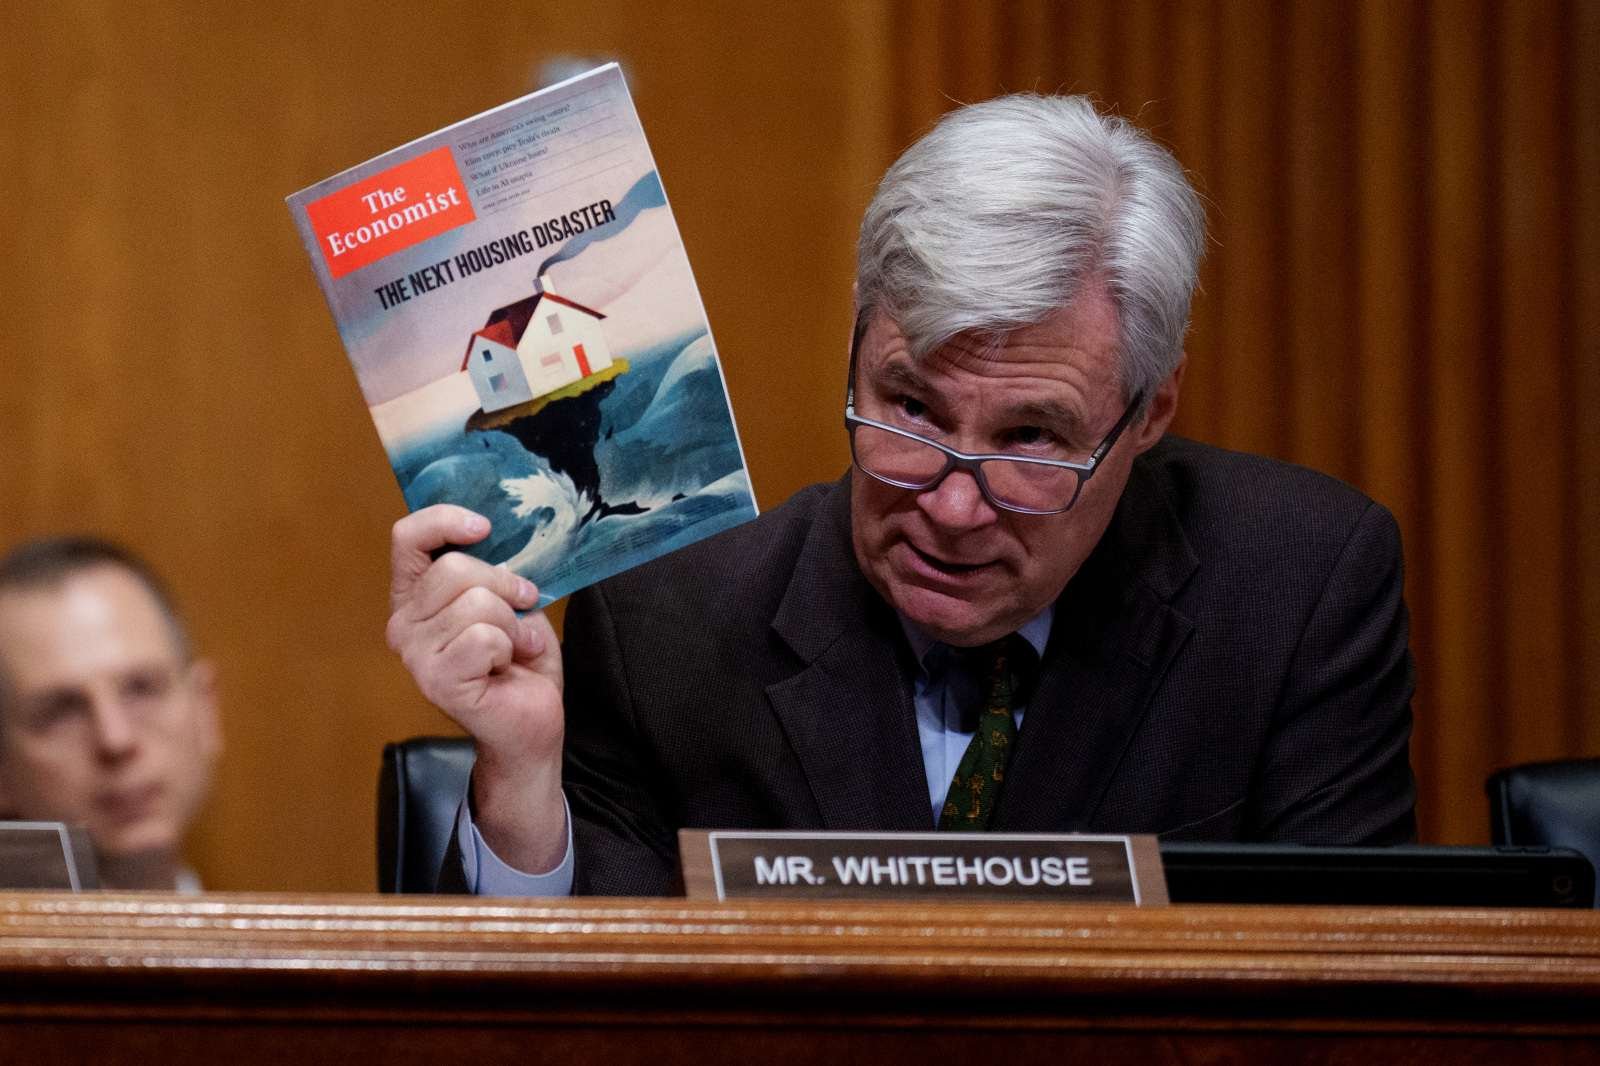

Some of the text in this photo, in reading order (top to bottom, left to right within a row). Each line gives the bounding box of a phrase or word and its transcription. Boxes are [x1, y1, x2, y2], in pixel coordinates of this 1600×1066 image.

[498, 156, 527, 171] Ukraine
[361, 186, 407, 214] The
[476, 186, 491, 197] Life
[326, 187, 461, 257] Economist
[374, 277, 411, 311] THE
[408, 259, 455, 297] NEXT
[454, 231, 534, 278] HOUSING
[532, 199, 617, 248] DISASTER
[753, 855, 1093, 886] MR. WHITEHOUSE
